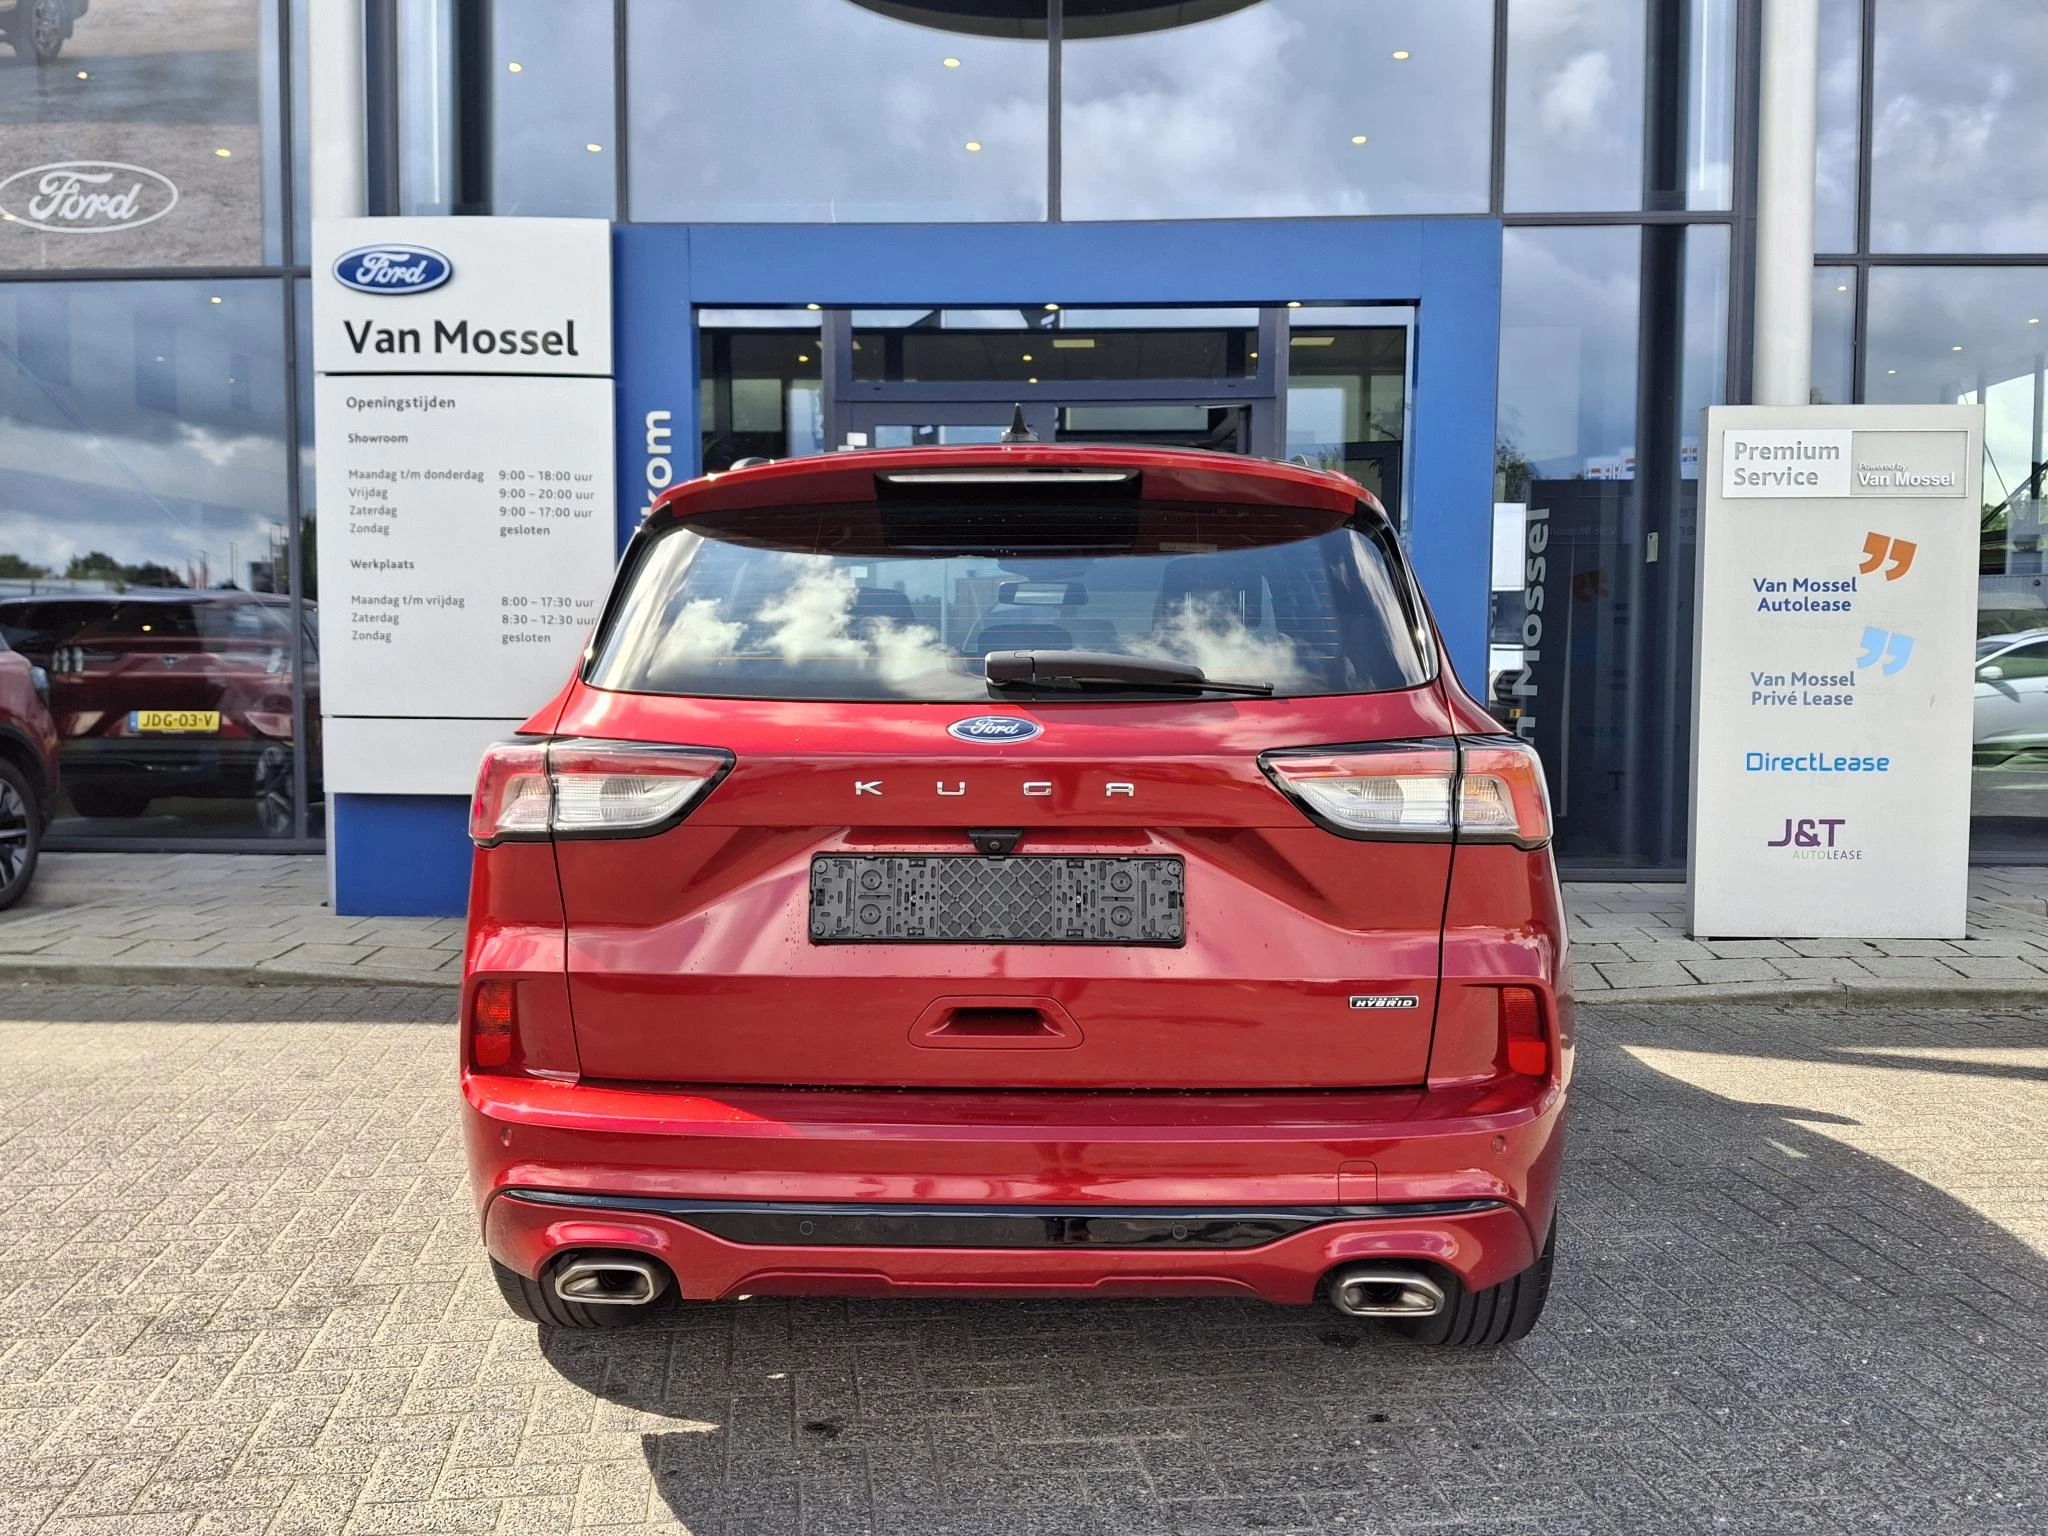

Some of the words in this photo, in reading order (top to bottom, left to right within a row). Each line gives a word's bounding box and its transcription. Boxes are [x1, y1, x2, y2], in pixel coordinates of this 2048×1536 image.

[29, 171, 142, 220] Ford
[343, 319, 421, 354] Van
[433, 319, 579, 356] Mossel
[346, 396, 456, 412] Openingstijden
[348, 432, 408, 443] Showroom
[1733, 440, 1841, 461] Premium
[1858, 462, 1895, 471] Powered
[1896, 462, 1909, 472] by
[349, 470, 397, 482] Maandag
[400, 469, 421, 480] t/m
[424, 469, 484, 482] donderdag
[499, 470, 525, 480] 9:00
[538, 470, 571, 481] 18:00
[574, 473, 594, 481] uur
[1733, 467, 1819, 486] Service
[1858, 472, 1890, 487] Van
[1894, 471, 1956, 487] Mossel
[349, 487, 388, 500] Vrijdag
[499, 488, 526, 498] 9:00
[538, 488, 573, 499] 20:00
[576, 492, 595, 500] uur
[349, 505, 398, 518] Zaterdag
[499, 506, 526, 517] 9:00
[538, 507, 570, 517] 17:00
[574, 510, 593, 518] uur
[350, 523, 390, 536] Zondag
[500, 524, 551, 538] gesloten
[350, 559, 415, 572] Werkplaats
[1752, 578, 1787, 592] Van
[1792, 577, 1857, 592] Mossel
[351, 595, 400, 608] Maandag
[403, 594, 423, 606] t/m
[426, 595, 465, 609] vrijdag
[540, 597, 572, 607] 17:30
[1512, 508, 1550, 696] Mossel
[1757, 596, 1852, 612] Autolease
[352, 612, 400, 625] Zaterdag
[502, 614, 528, 625] 8:30
[540, 615, 573, 625] 12:30
[352, 630, 392, 643] Zondag
[502, 632, 551, 645] gesloten
[1750, 672, 1786, 686] Van
[1790, 671, 1856, 687] Mossel
[1751, 690, 1798, 706] Privé
[1803, 691, 1854, 706] Lease
[143, 713, 213, 727] JDG-03-V
[1746, 752, 1890, 772] DirectLease
[855, 780, 1135, 797] KUGA
[1767, 818, 1846, 847] J&T
[1792, 850, 1863, 860] AUTOLEASE
